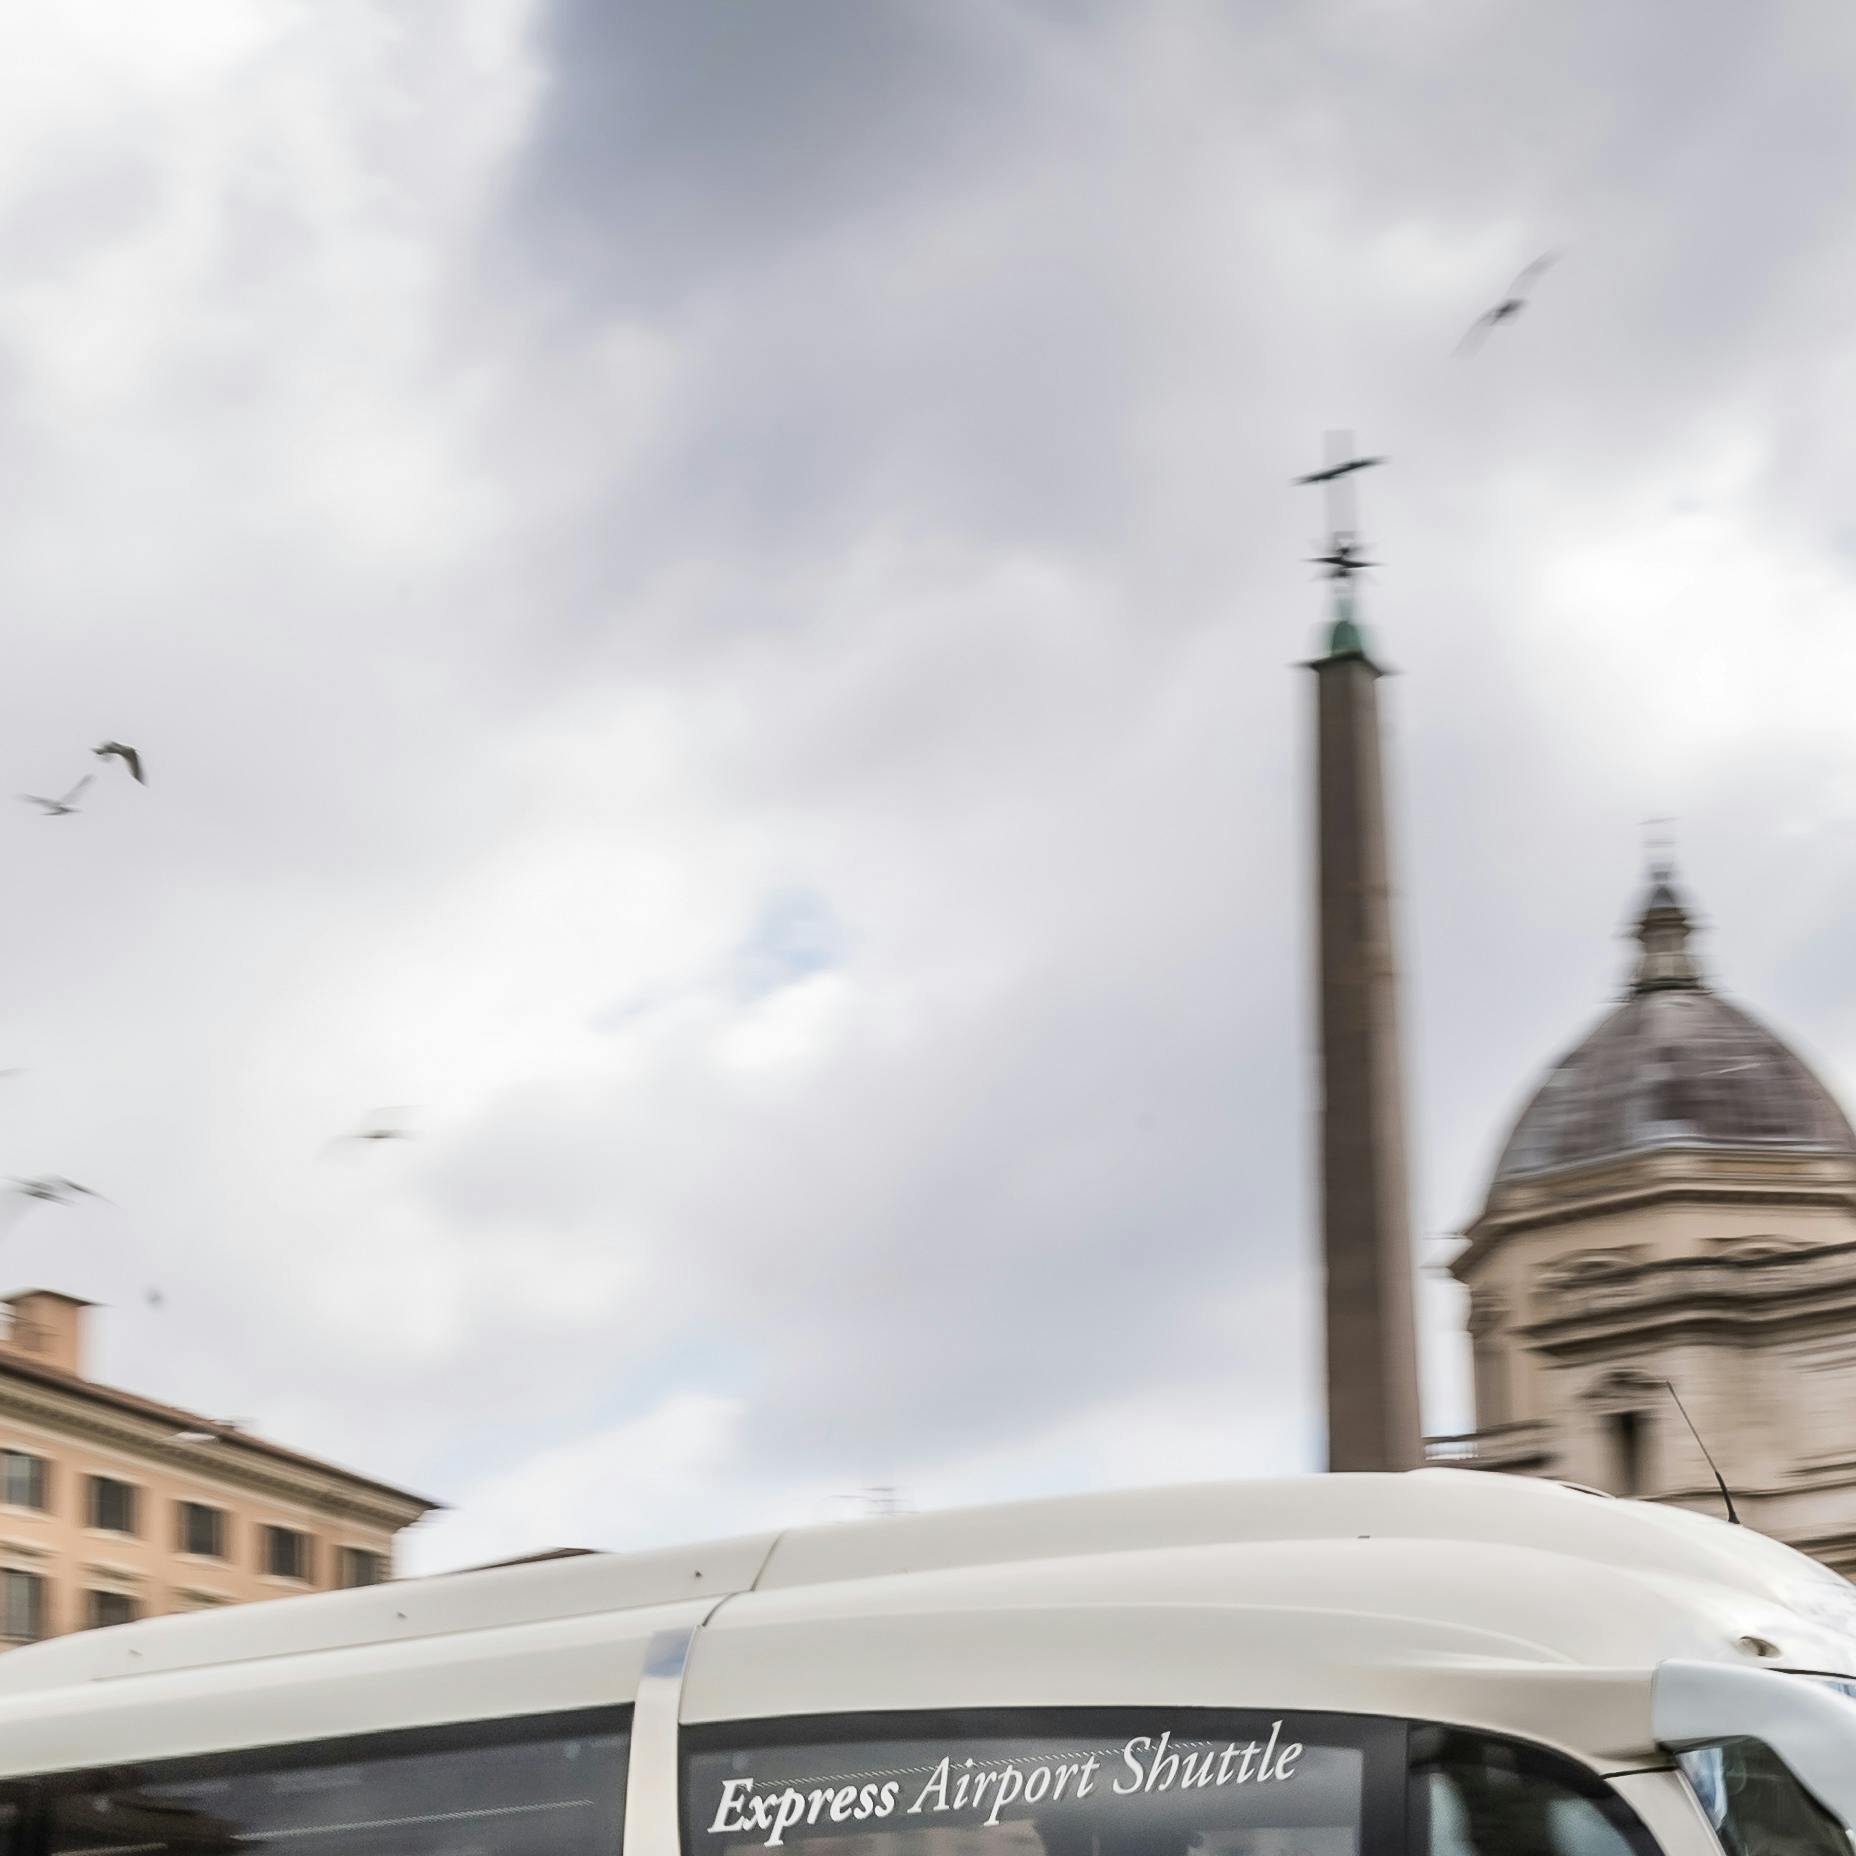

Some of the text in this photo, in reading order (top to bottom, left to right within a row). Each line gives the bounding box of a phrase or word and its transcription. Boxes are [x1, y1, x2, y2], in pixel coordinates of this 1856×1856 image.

[707, 1720, 1304, 1847] Express Airport Shuttle
